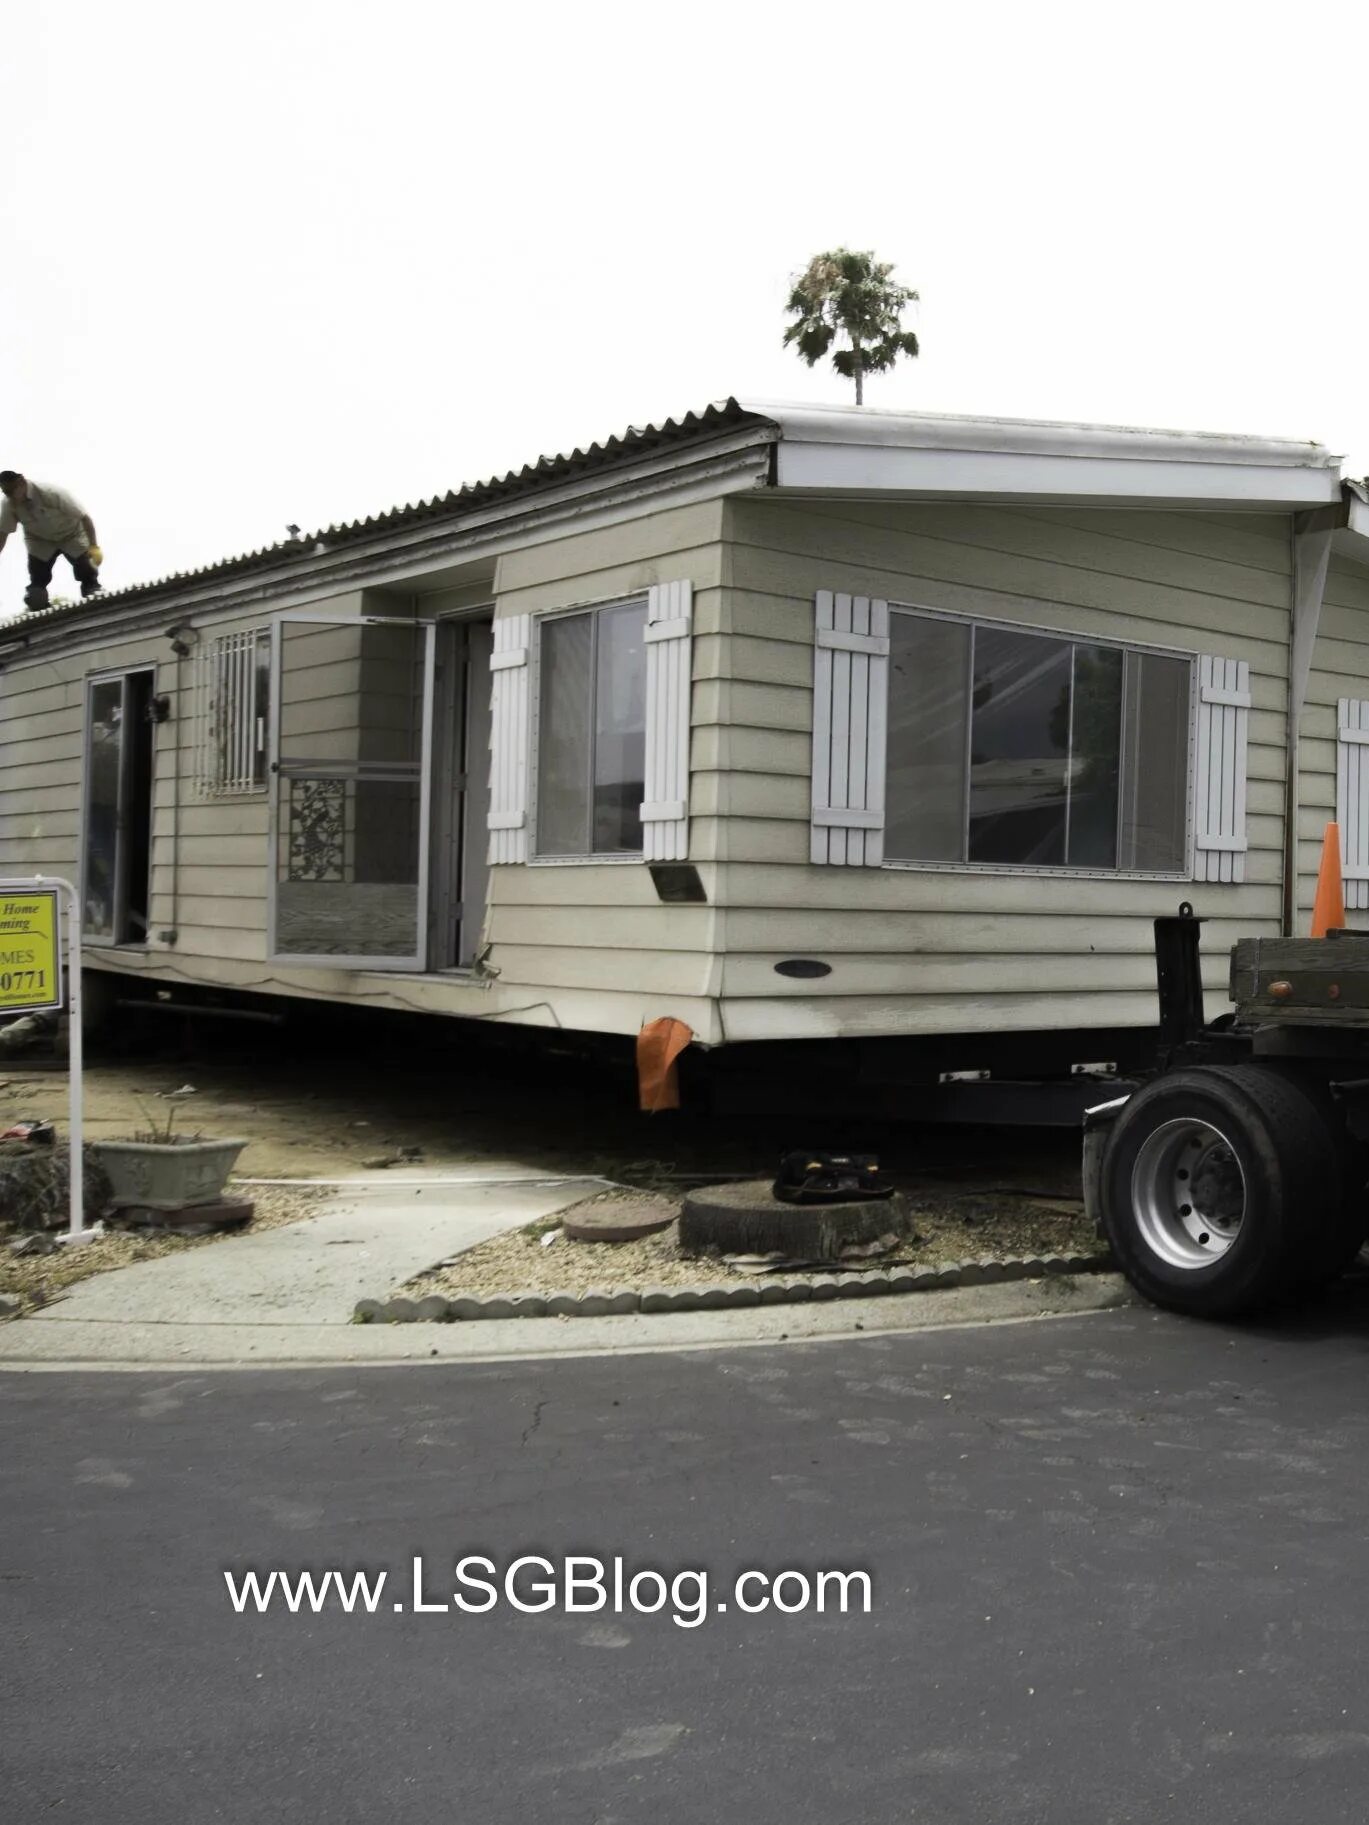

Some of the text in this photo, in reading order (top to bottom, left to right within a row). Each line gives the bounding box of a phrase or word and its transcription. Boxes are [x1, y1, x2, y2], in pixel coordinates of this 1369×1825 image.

[3, 904, 40, 915] Home
[0, 950, 35, 965] MES
[0, 970, 45, 991] 0771
